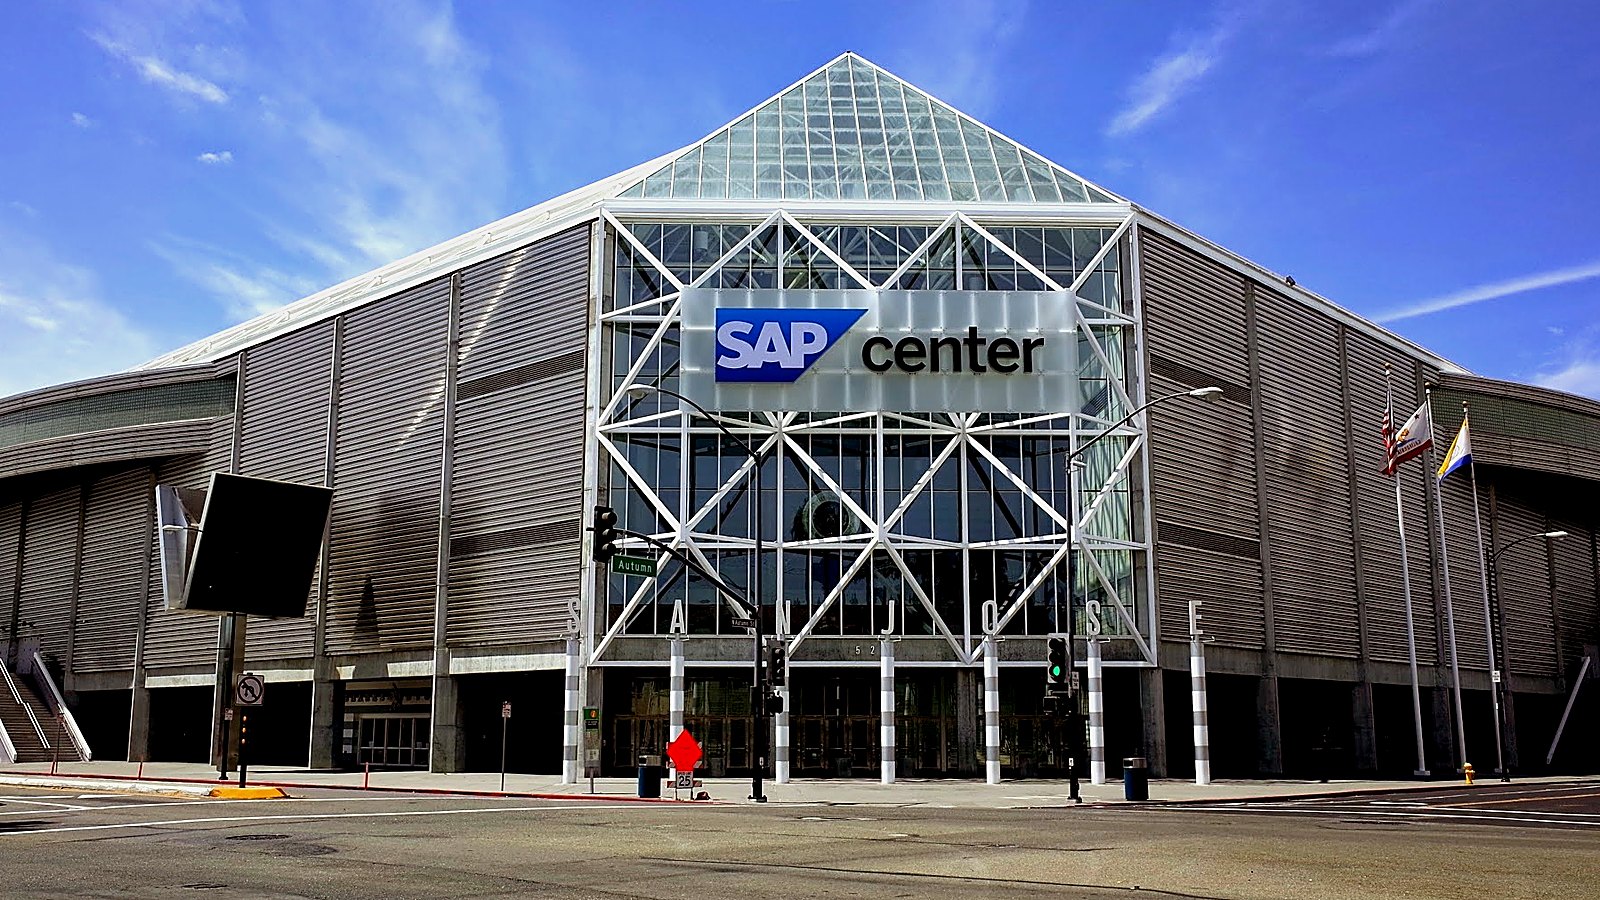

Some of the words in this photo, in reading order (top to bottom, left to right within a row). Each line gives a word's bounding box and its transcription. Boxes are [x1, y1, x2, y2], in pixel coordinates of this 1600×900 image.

[717, 320, 828, 369] SAP
[861, 326, 1045, 374] center
[618, 560, 652, 573] Autumn
[679, 775, 691, 786] 25
